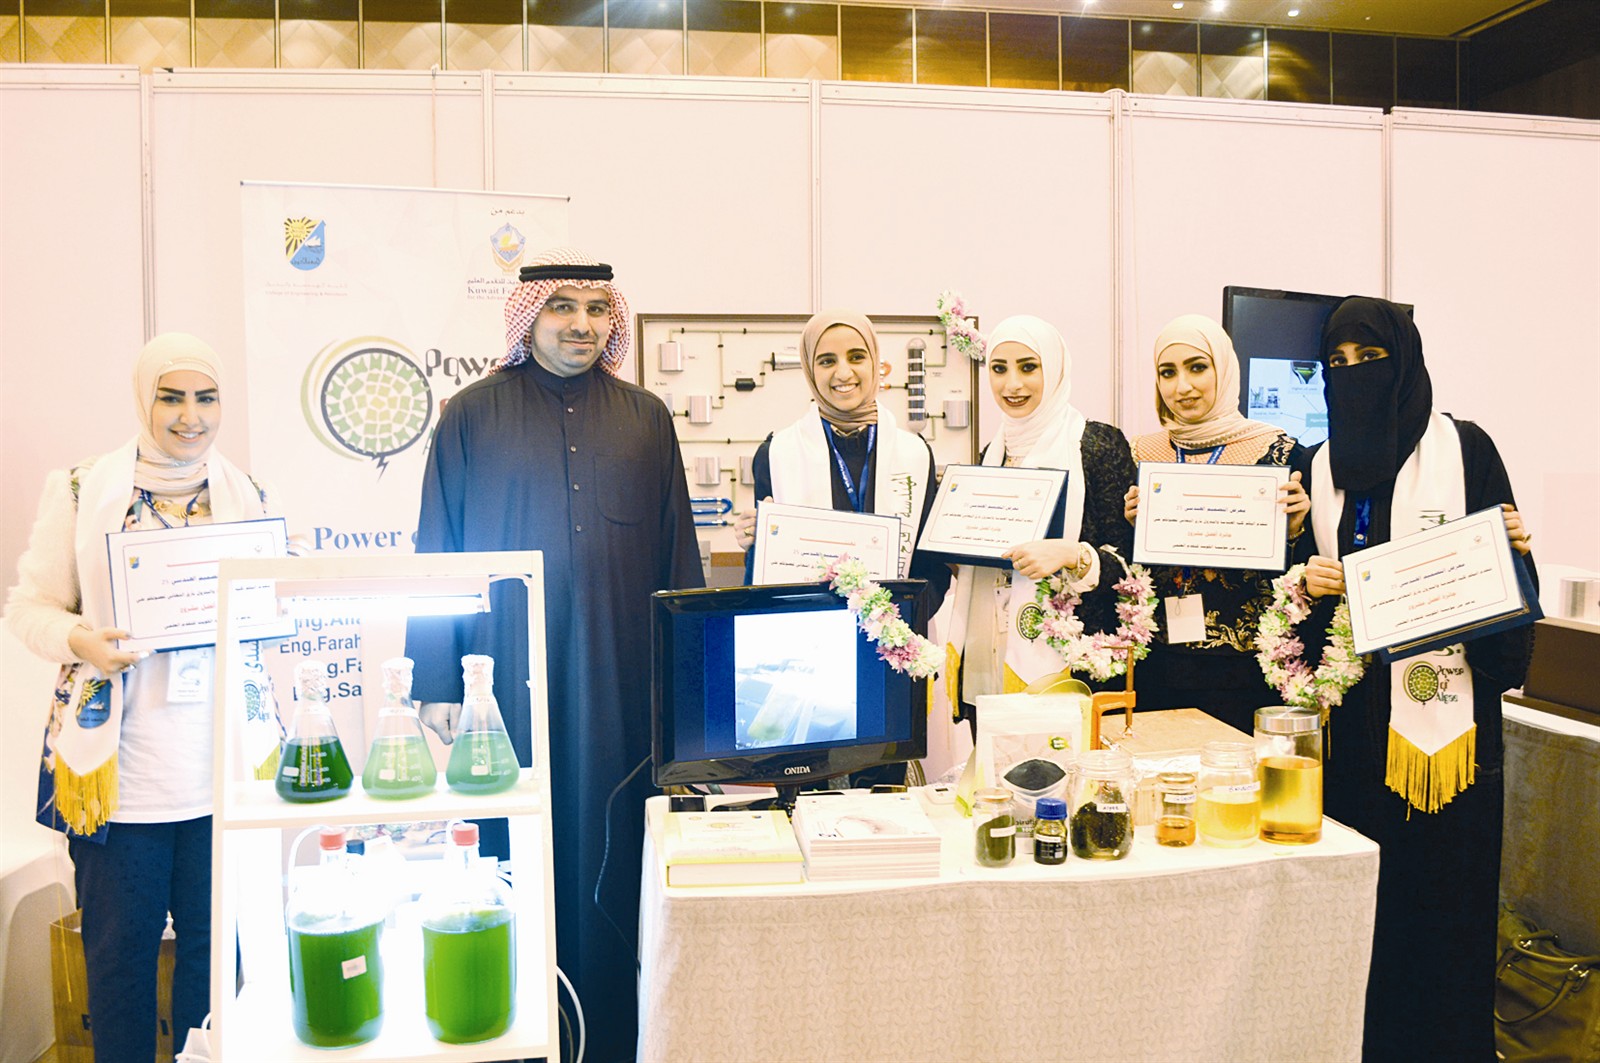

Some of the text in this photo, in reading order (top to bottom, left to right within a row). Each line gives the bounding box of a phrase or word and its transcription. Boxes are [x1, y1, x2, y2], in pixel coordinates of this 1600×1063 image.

[467, 286, 500, 295] Kuwait
[313, 527, 402, 550] Power
[784, 765, 811, 776] ONIDA
